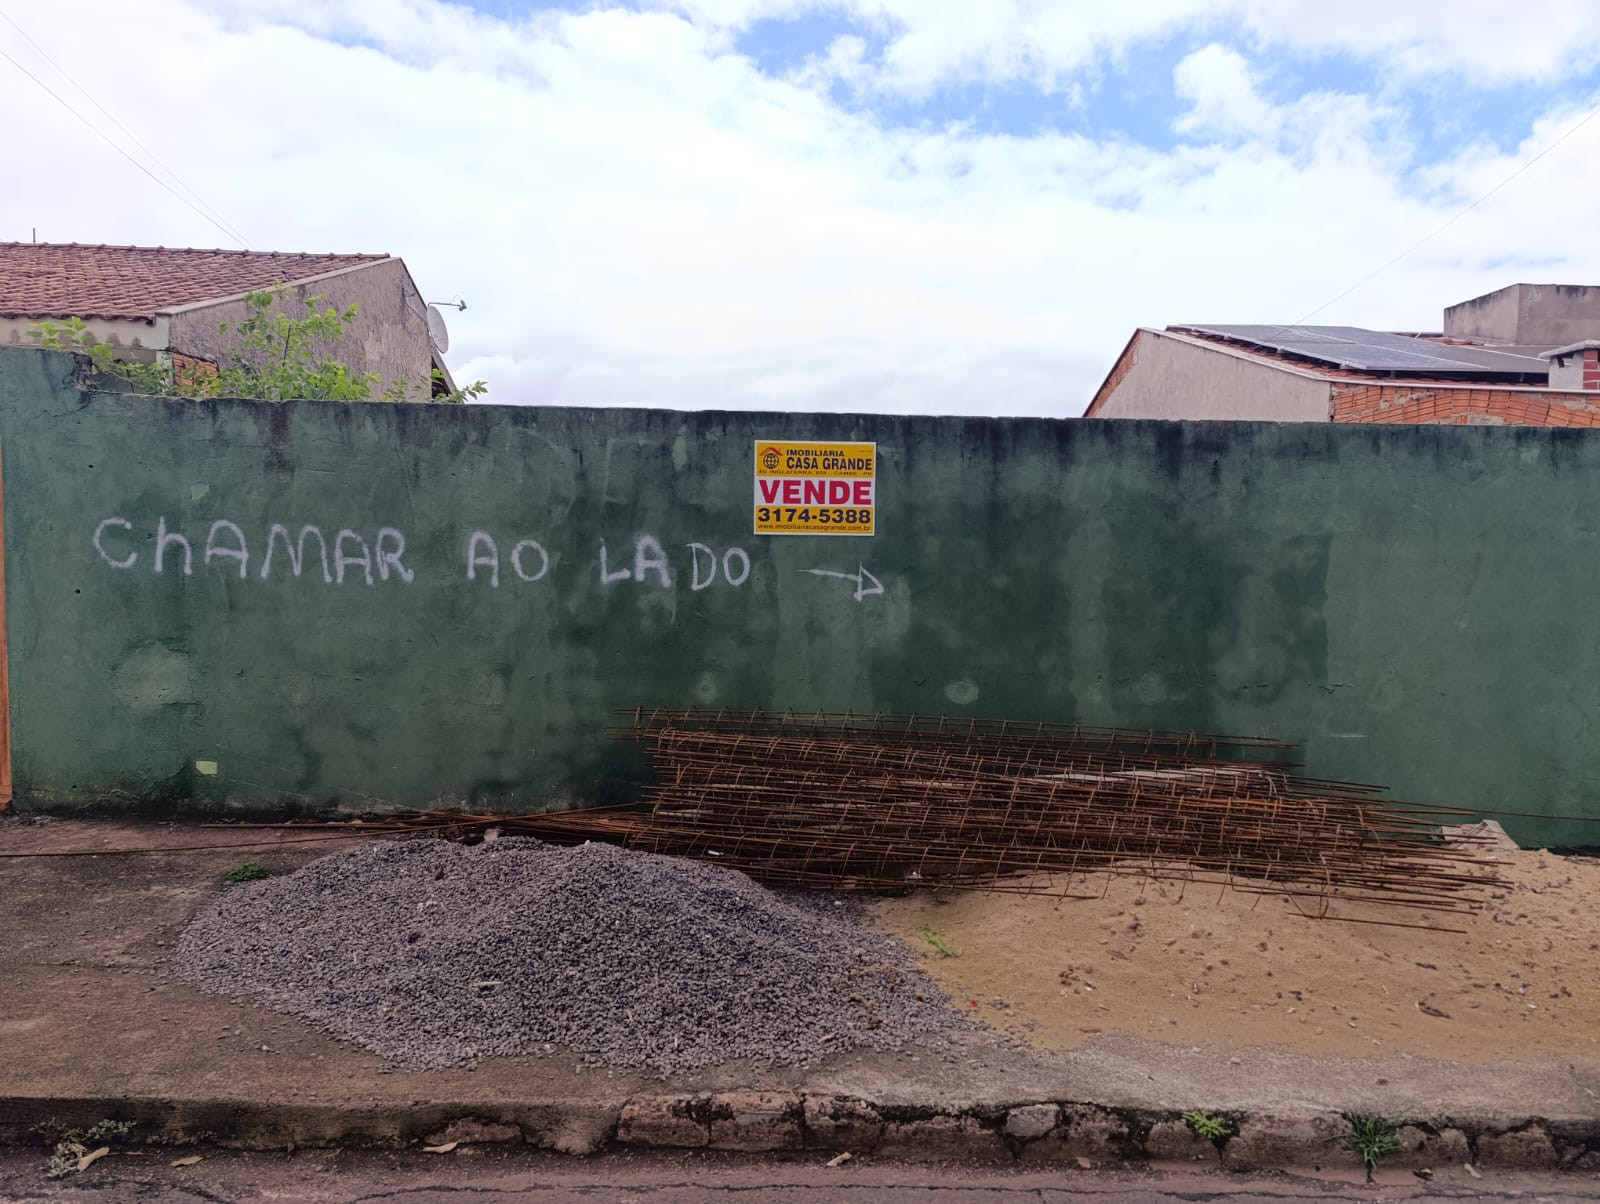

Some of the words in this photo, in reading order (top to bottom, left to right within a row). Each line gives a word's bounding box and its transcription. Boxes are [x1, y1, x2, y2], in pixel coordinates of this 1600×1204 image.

[786, 457, 818, 470] CASA
[822, 458, 872, 471] GRANDE
[758, 479, 872, 505] VENDE
[757, 508, 871, 524] 3174-5388
[466, 530, 549, 587] AO
